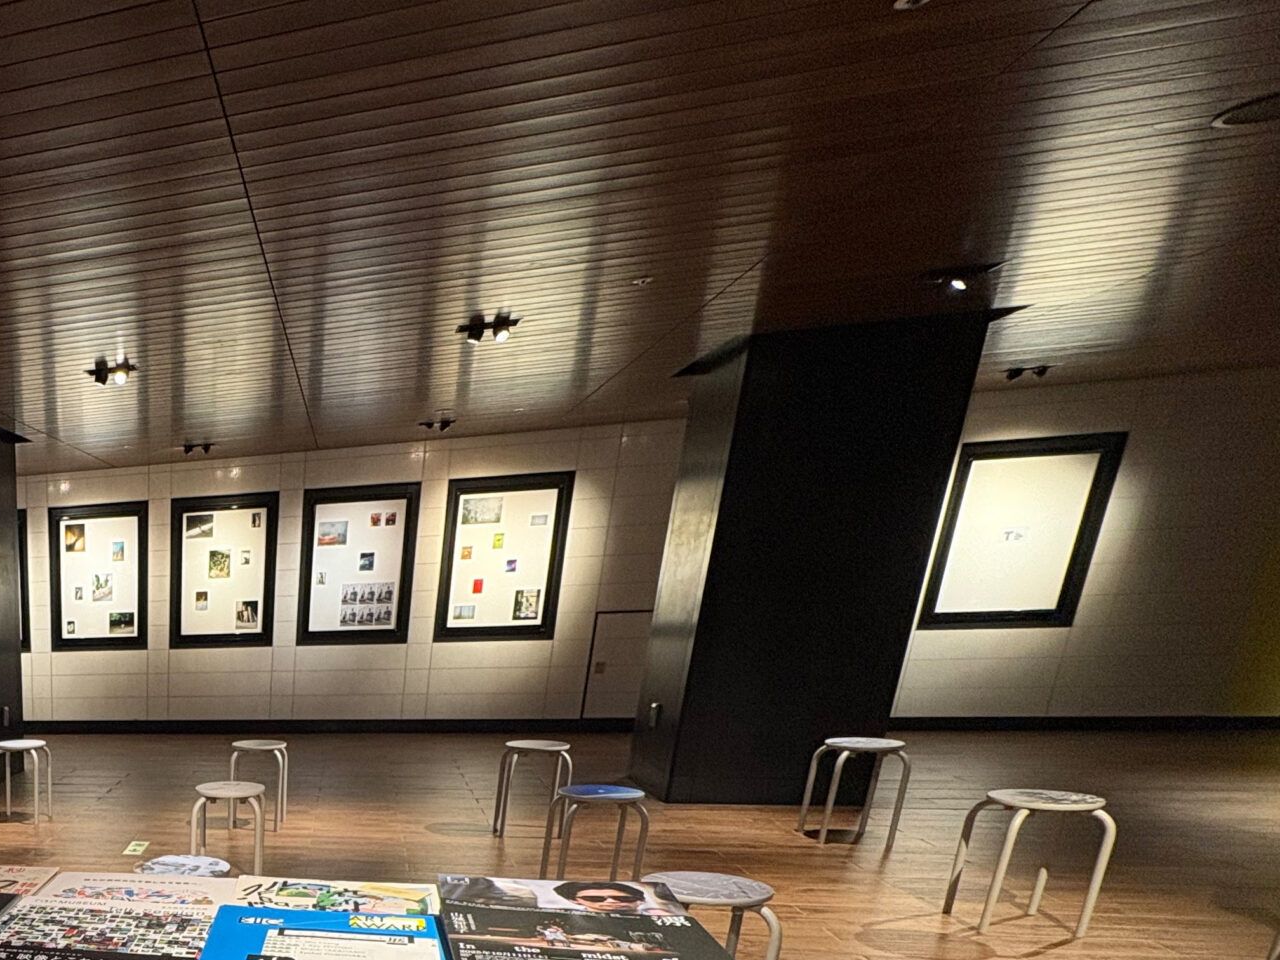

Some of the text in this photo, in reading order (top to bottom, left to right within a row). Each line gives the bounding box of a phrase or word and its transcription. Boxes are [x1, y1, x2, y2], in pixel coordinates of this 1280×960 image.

[350, 915, 386, 923] ART
[349, 922, 426, 932] AWARD
[458, 942, 475, 950] In
[513, 946, 541, 954] the
[581, 952, 629, 960] midst
